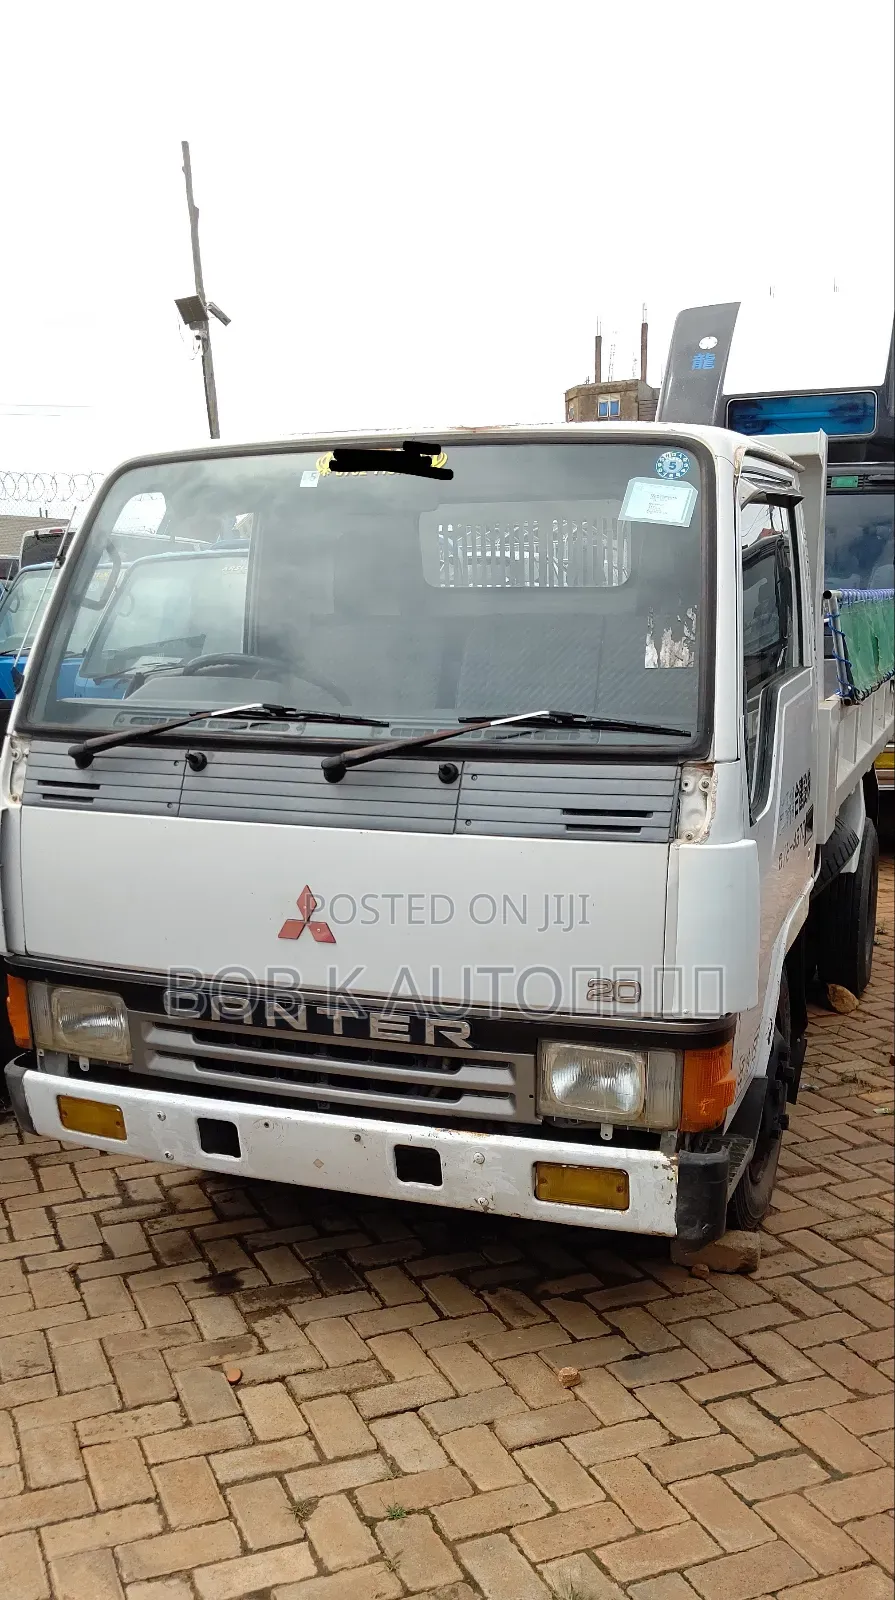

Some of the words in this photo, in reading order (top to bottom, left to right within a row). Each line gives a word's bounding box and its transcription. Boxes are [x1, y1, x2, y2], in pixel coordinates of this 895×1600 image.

[669, 461, 677, 470] 5
[586, 978, 642, 1004] 20
[163, 990, 474, 1049] CANTER
